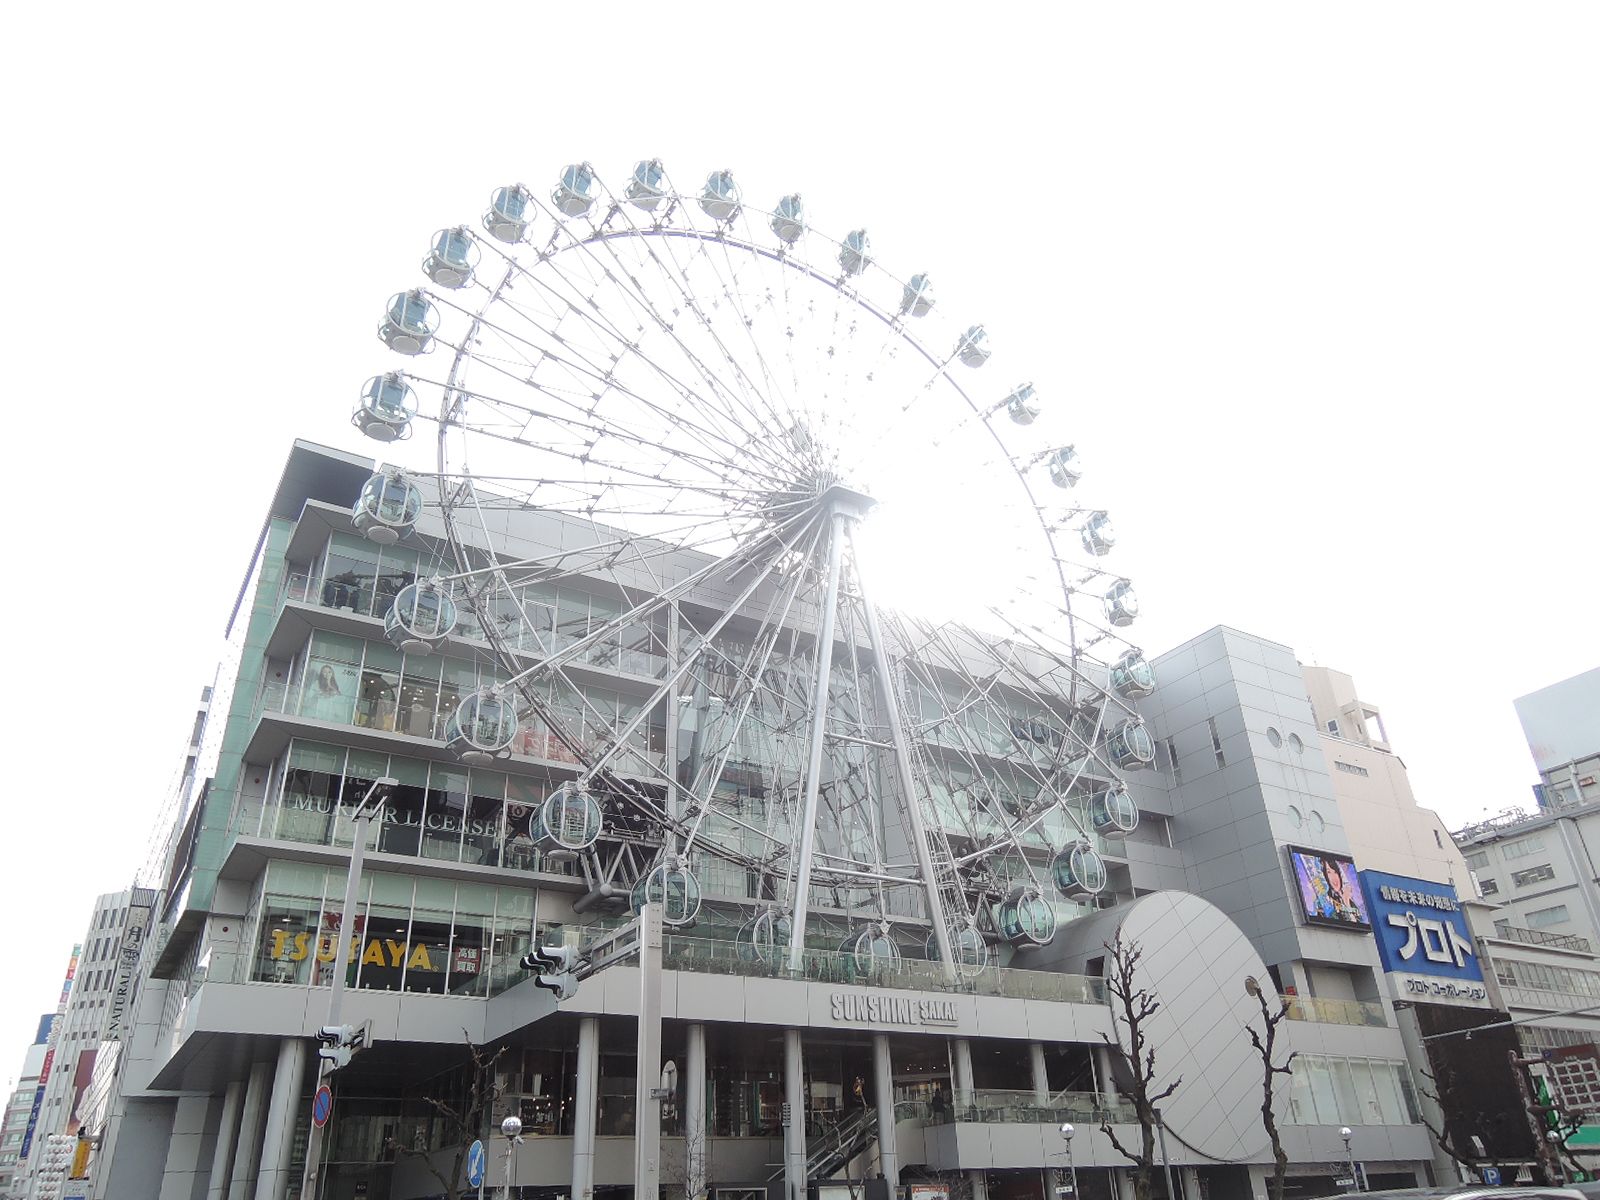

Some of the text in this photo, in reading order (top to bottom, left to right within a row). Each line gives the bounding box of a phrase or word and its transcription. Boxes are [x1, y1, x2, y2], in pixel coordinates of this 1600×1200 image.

[403, 810, 499, 836] LICENSE
[1387, 910, 1473, 968] プロト
[108, 971, 132, 1032] NATURAL
[1406, 979, 1430, 994] プロト
[830, 991, 959, 1026] SUNSHINE SAKAE
